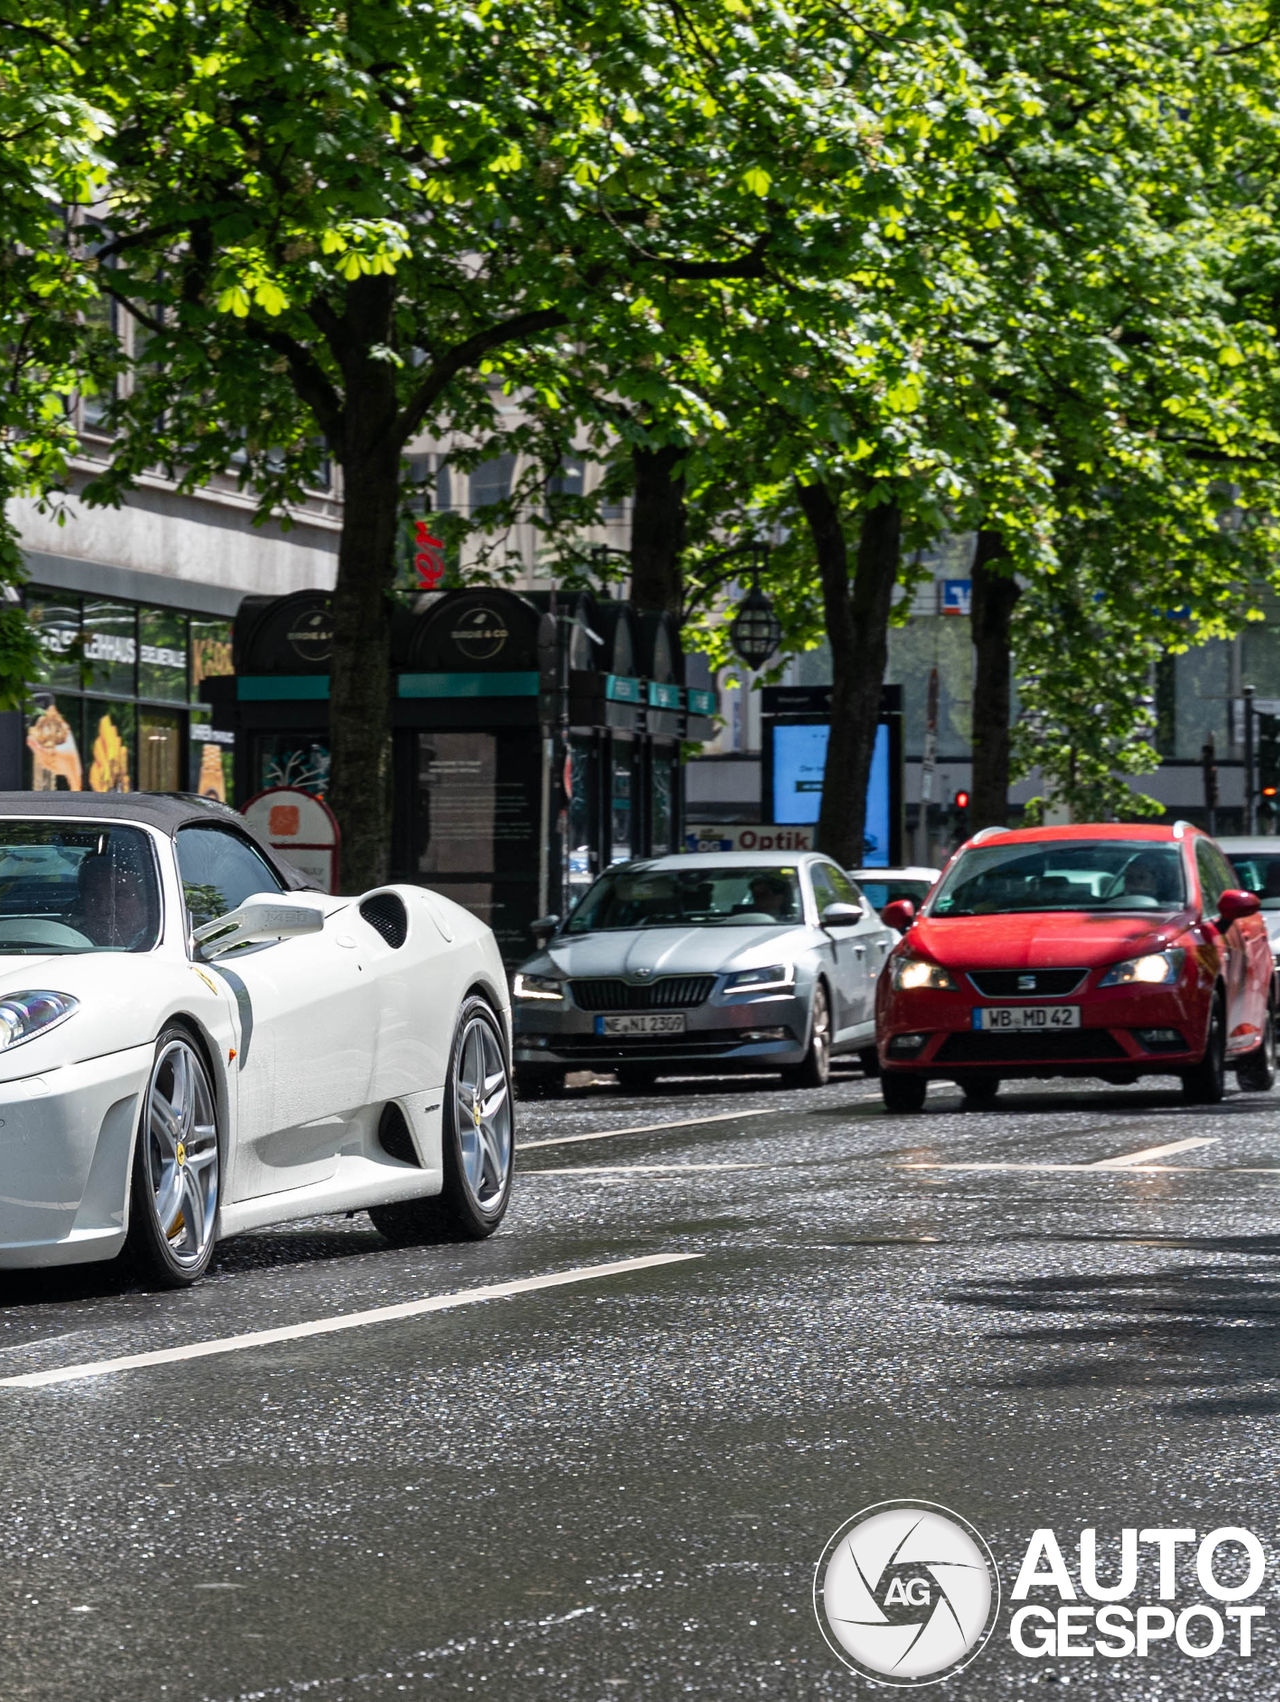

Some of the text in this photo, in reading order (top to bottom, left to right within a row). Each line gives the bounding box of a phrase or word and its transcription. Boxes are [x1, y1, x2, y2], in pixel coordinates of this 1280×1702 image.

[739, 830, 809, 850] Optik
[989, 1009, 1073, 1027] WB MD 42
